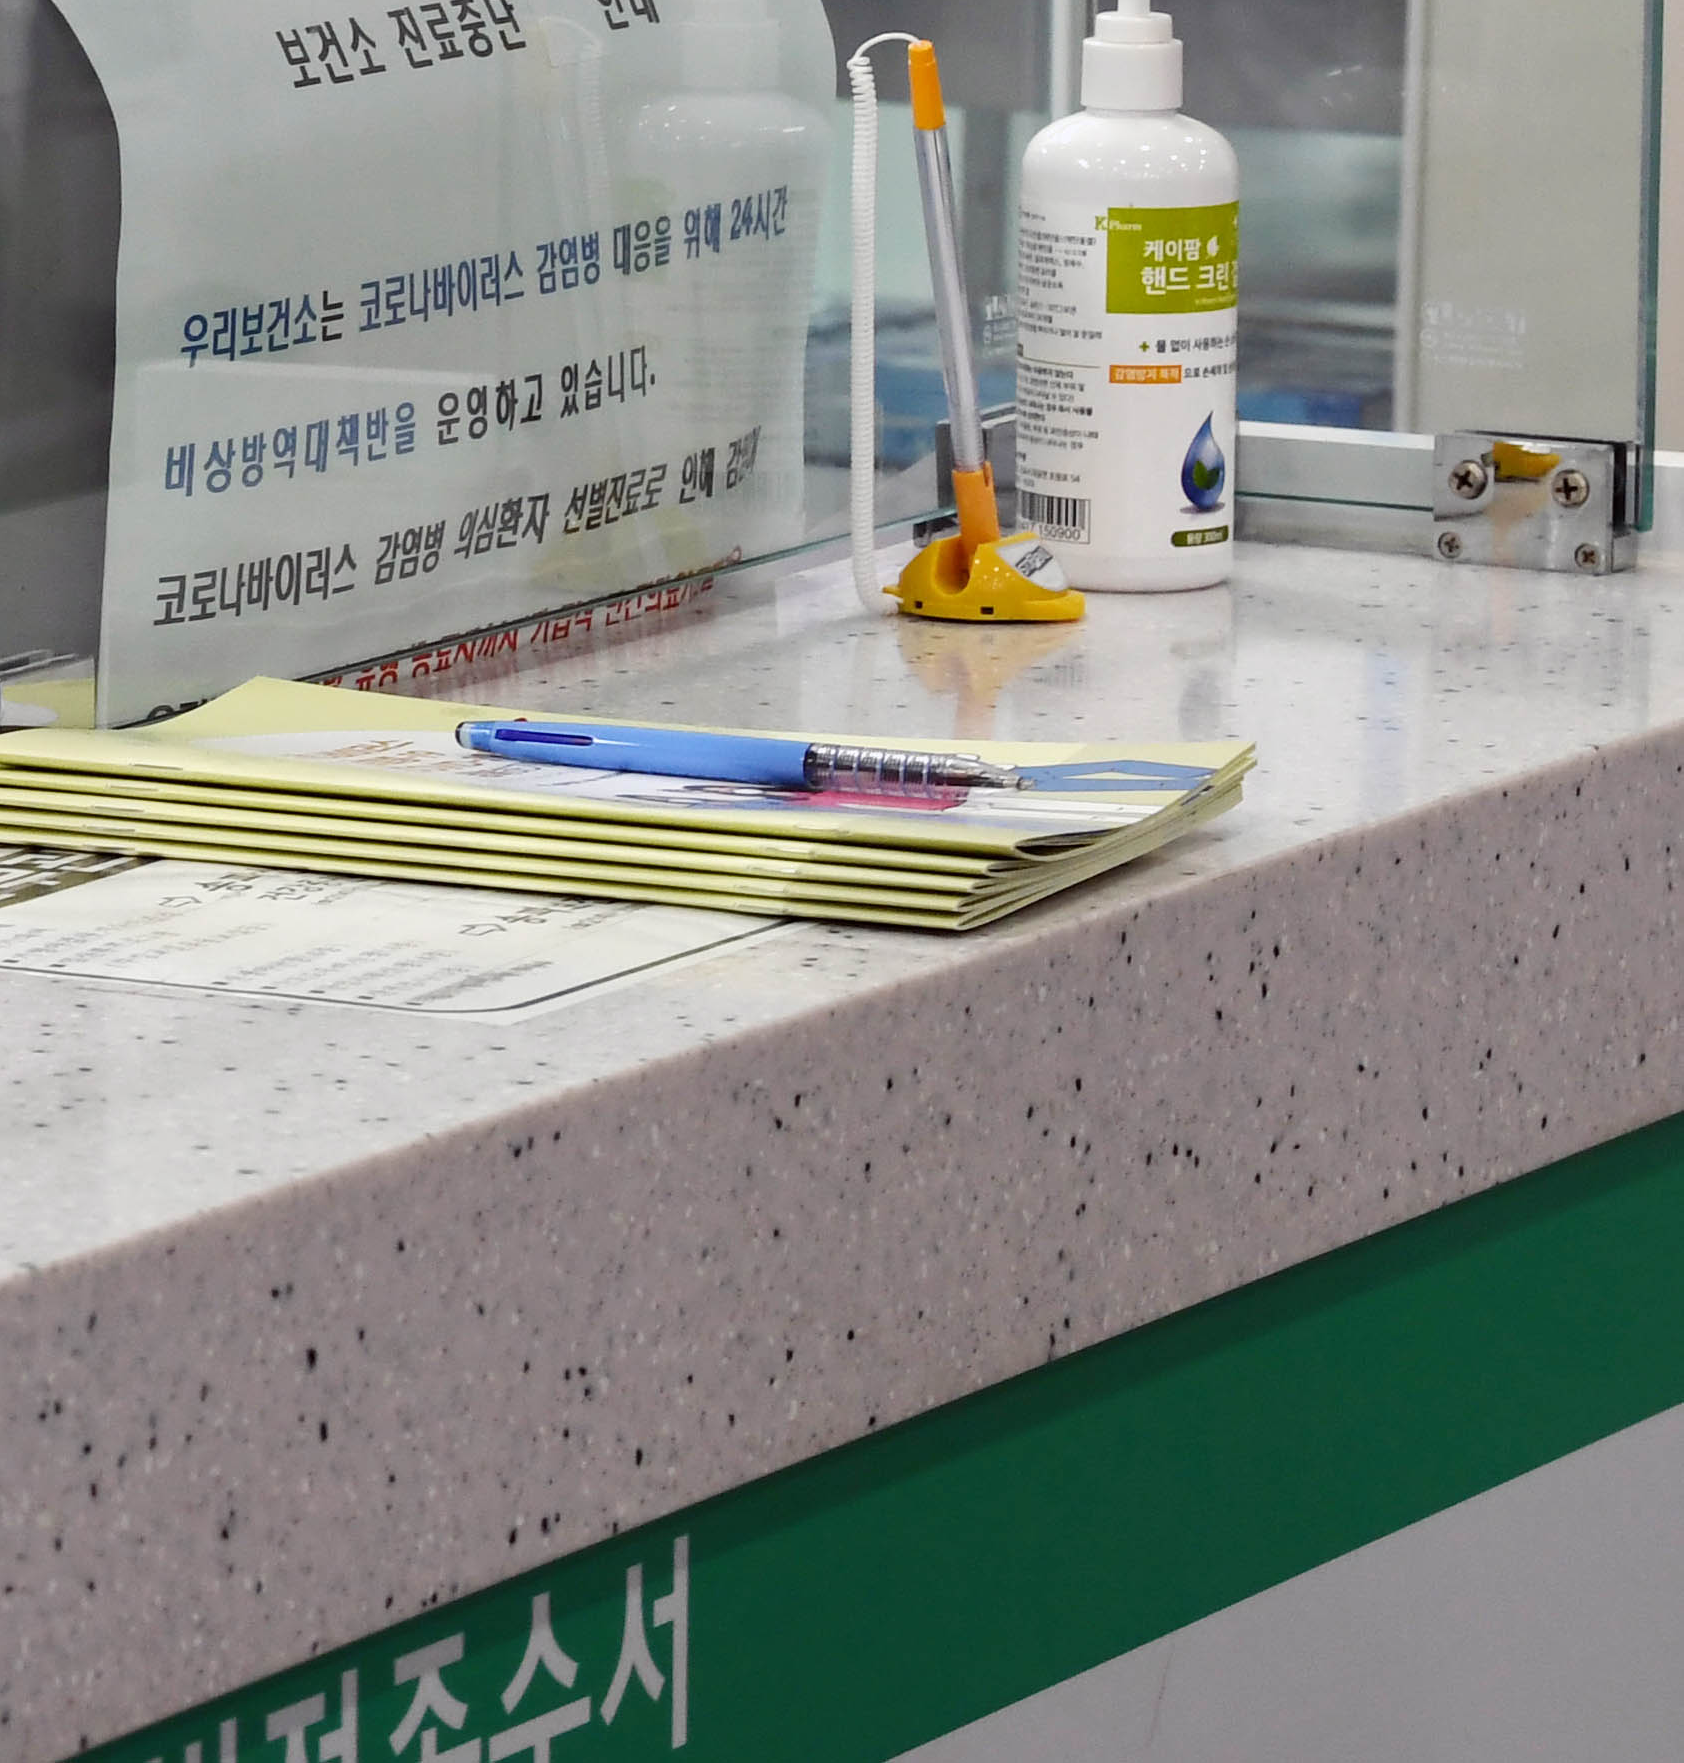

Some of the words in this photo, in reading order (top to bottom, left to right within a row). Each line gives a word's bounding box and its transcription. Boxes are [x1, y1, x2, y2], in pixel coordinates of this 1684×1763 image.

[274, 16, 387, 89] 보건소
[180, 290, 344, 368] 우리보건소는
[358, 250, 525, 333] 코로나바이러스
[536, 231, 600, 295] 감염병
[613, 215, 672, 276] 대응을
[684, 203, 722, 260] 위해
[729, 185, 788, 241] 24시간
[1139, 265, 1191, 296] 핸드
[1143, 238, 1202, 262] 케이팜
[164, 401, 416, 498] 비상방역대책반을
[436, 374, 544, 447] 운영하고
[559, 344, 657, 419] 있습니다.
[153, 542, 358, 627] 코로나바이러스
[374, 519, 447, 586] 감염병
[453, 491, 551, 560] 의심환자
[562, 463, 668, 535] 선별진료로
